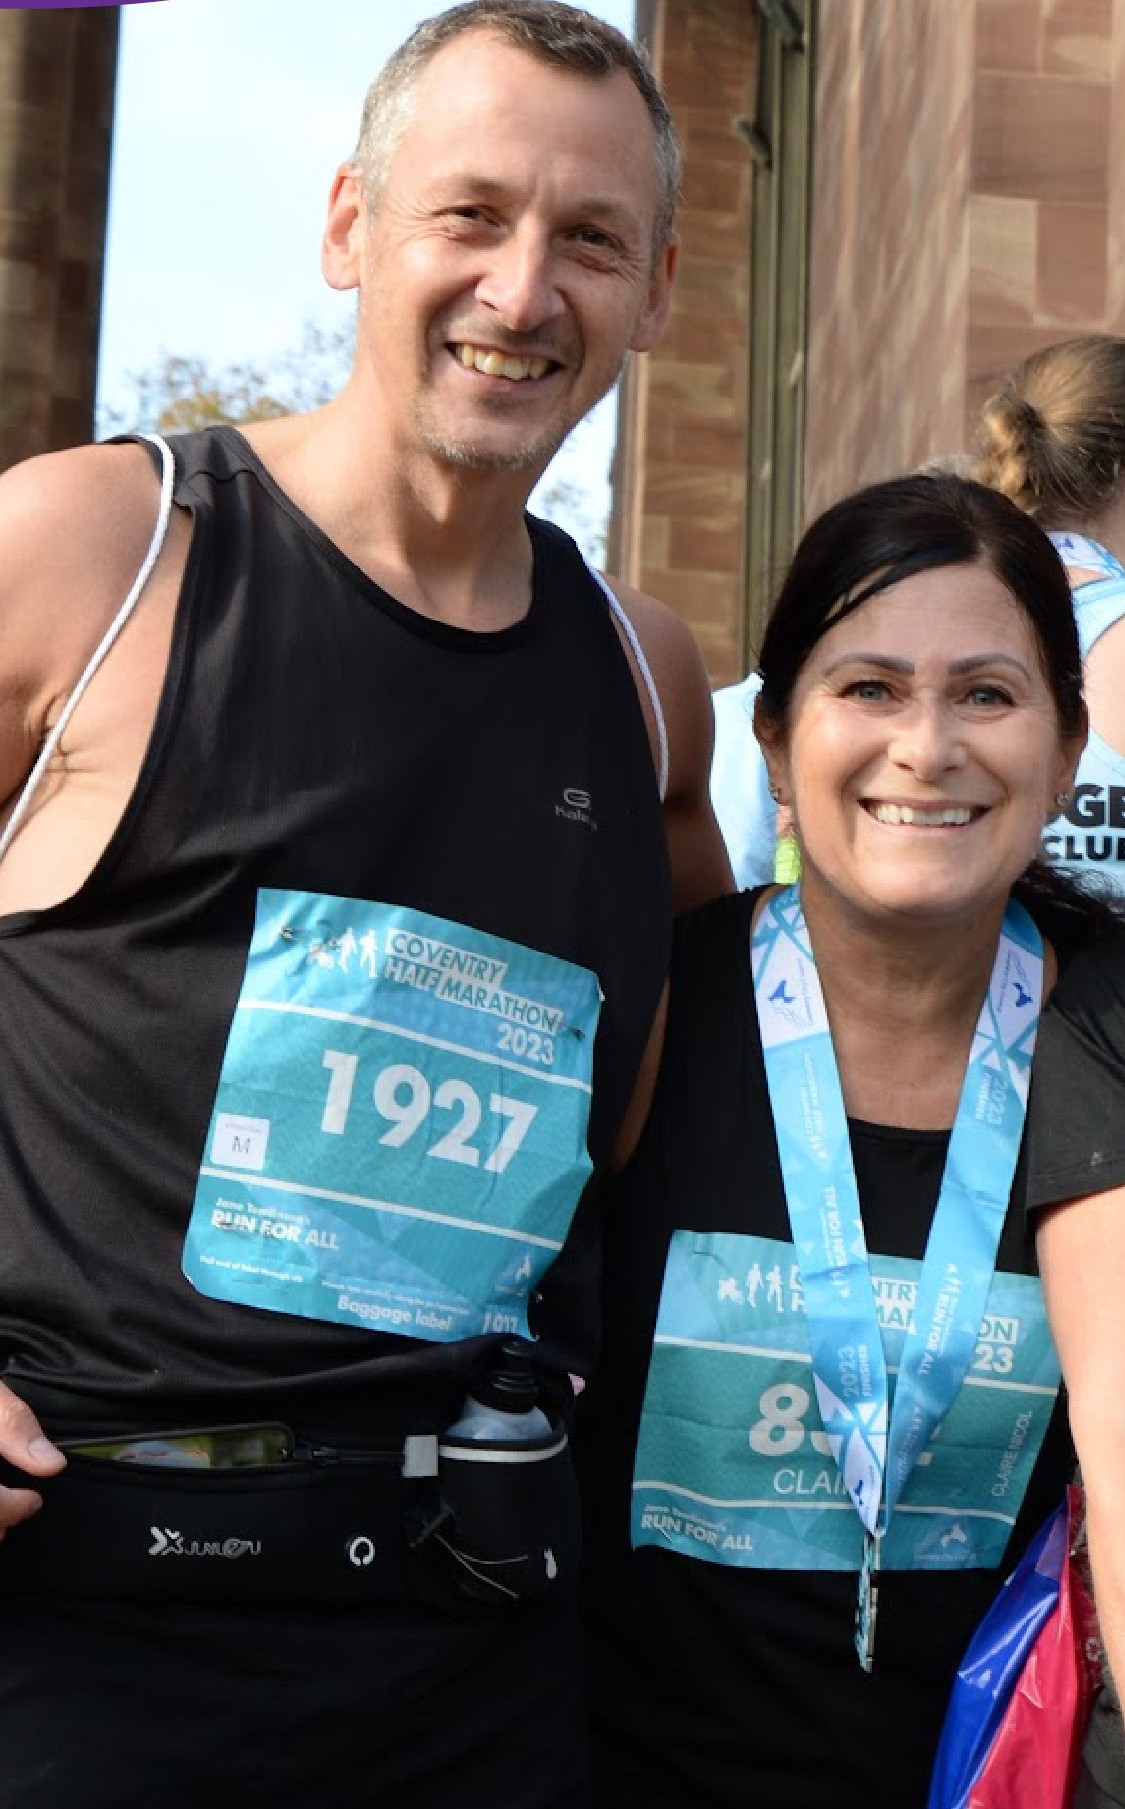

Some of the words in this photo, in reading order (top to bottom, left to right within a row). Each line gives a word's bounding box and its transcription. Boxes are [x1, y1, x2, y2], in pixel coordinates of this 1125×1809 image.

[391, 932, 504, 985] COVENTRY
[384, 956, 440, 992] HALF
[439, 977, 560, 1032] MARATHON
[496, 1023, 554, 1065] 2023
[321, 1050, 538, 1174] 1927
[231, 1135, 251, 1155] M
[211, 1208, 256, 1232] RUN
[260, 1219, 301, 1242] FOR
[305, 1229, 340, 1250] ALL
[337, 1294, 412, 1324] Baggage
[415, 1308, 452, 1331] label
[972, 1345, 1014, 1374] 23
[773, 1469, 847, 1495] CLAI
[641, 1514, 681, 1532] RUN
[685, 1522, 718, 1545] FOR
[720, 1534, 753, 1551] ALL
